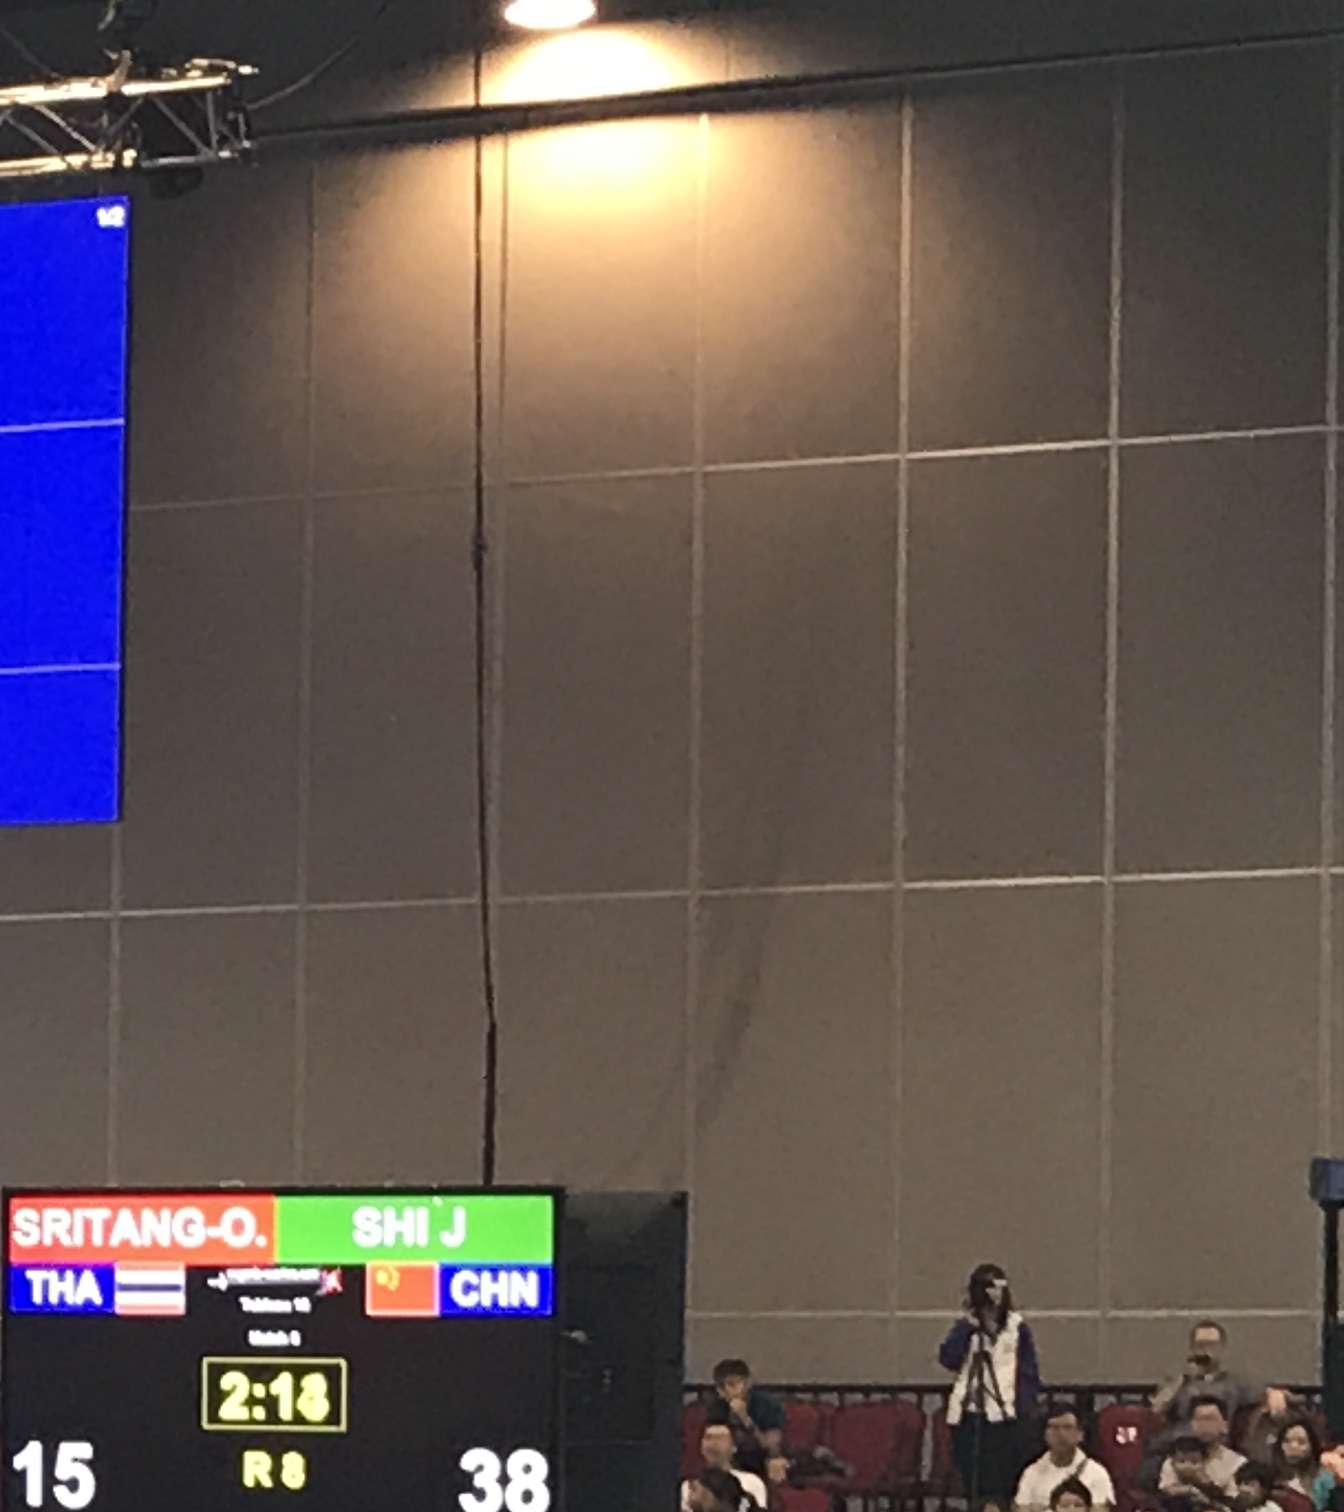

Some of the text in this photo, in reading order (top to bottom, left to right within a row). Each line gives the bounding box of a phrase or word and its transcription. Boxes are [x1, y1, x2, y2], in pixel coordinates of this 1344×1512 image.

[11, 1206, 269, 1249] SRITANG-O.
[351, 1204, 468, 1249] SHI J
[24, 1268, 103, 1306] THA
[449, 1269, 540, 1308] CHN
[10, 1439, 98, 1511] 15
[242, 1449, 307, 1490] R 8
